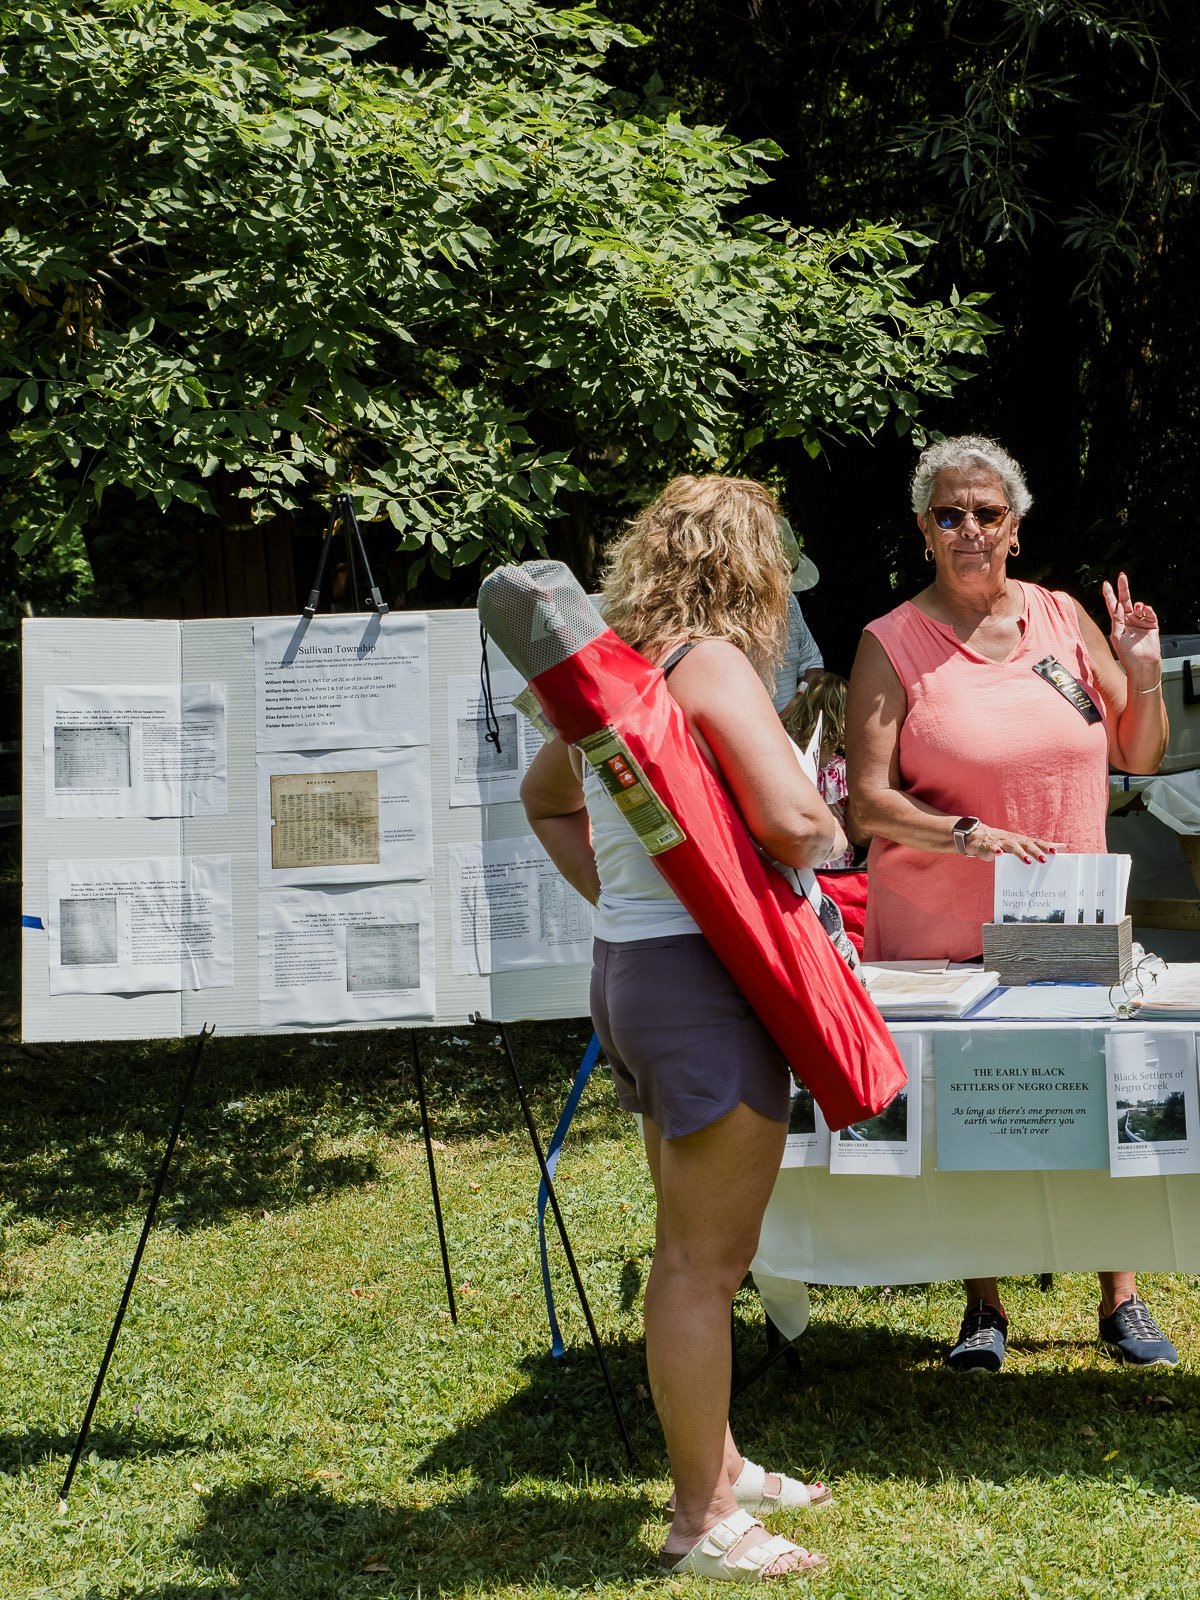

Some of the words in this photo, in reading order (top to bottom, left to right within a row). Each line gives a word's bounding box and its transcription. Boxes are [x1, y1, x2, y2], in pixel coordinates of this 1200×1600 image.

[298, 644, 333, 655] Sullivan
[335, 644, 376, 654] Township
[1002, 900, 1026, 908] Negro
[973, 1068, 993, 1076] THE
[996, 1068, 1029, 1076] EARLY
[1032, 1068, 1065, 1076] BLACK
[1114, 1073, 1138, 1081] Black
[1139, 1071, 1173, 1081] Settlers
[1175, 1070, 1184, 1078] of
[1114, 1083, 1140, 1093] Negro
[1143, 1082, 1168, 1091] Creek
[966, 1107, 984, 1117] long
[999, 1106, 1026, 1115] there's
[1041, 1108, 1073, 1119] person
[990, 1117, 1007, 1125] who
[1010, 1116, 1056, 1125] remembers
